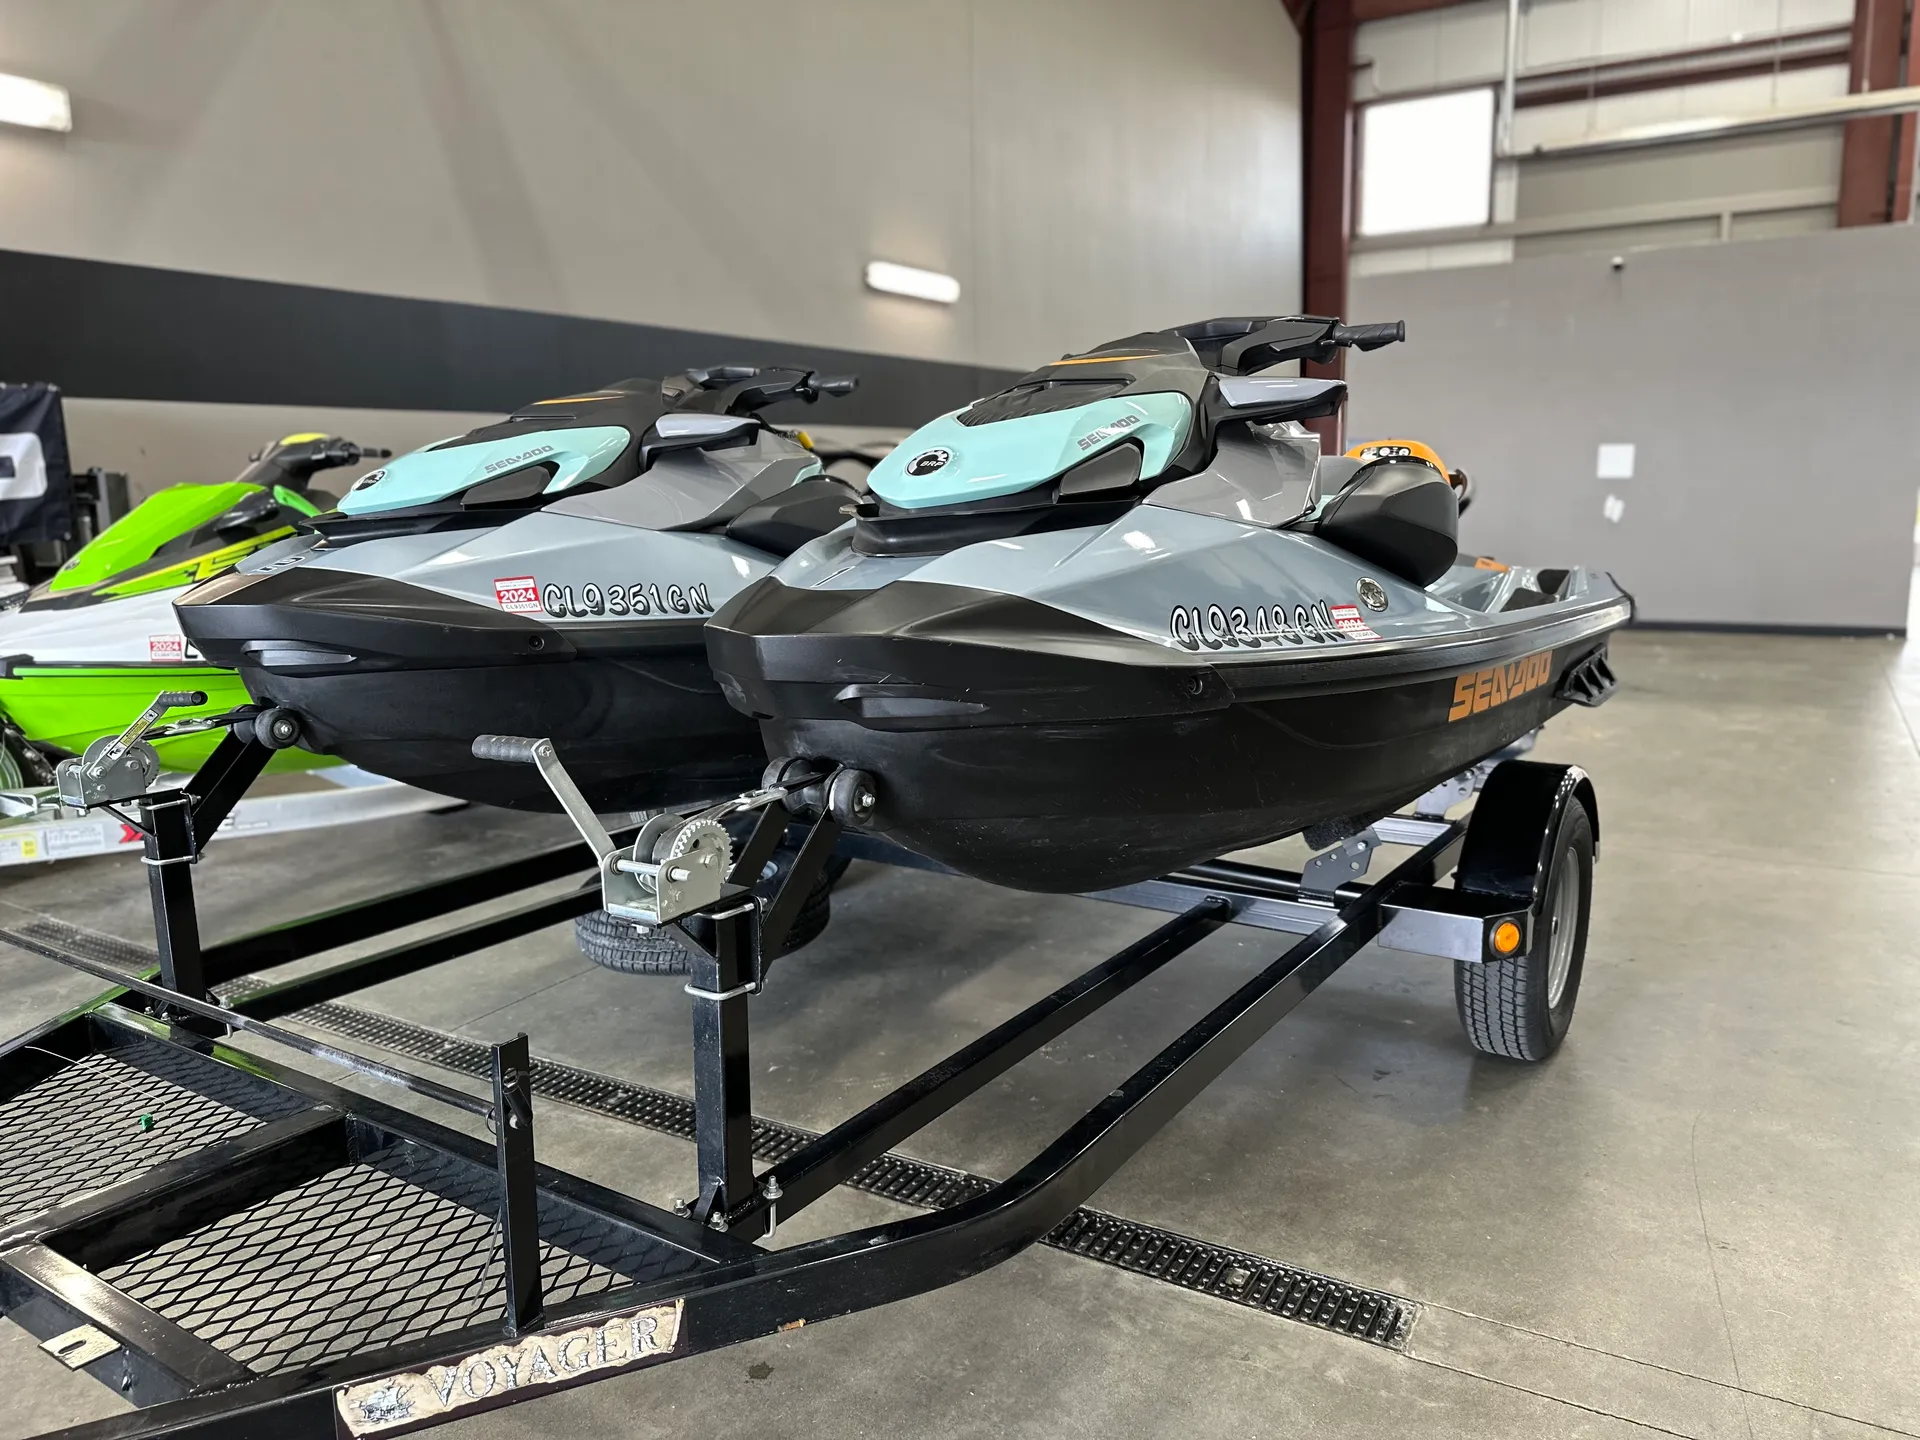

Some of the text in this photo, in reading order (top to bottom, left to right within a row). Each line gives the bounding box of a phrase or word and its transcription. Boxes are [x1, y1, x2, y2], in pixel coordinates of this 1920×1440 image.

[500, 588, 536, 602] 2024
[542, 582, 715, 619] CL9351GN
[1170, 598, 1346, 651] CL9348GN
[151, 641, 180, 651] 2024
[426, 1315, 660, 1408] VOYAGER
